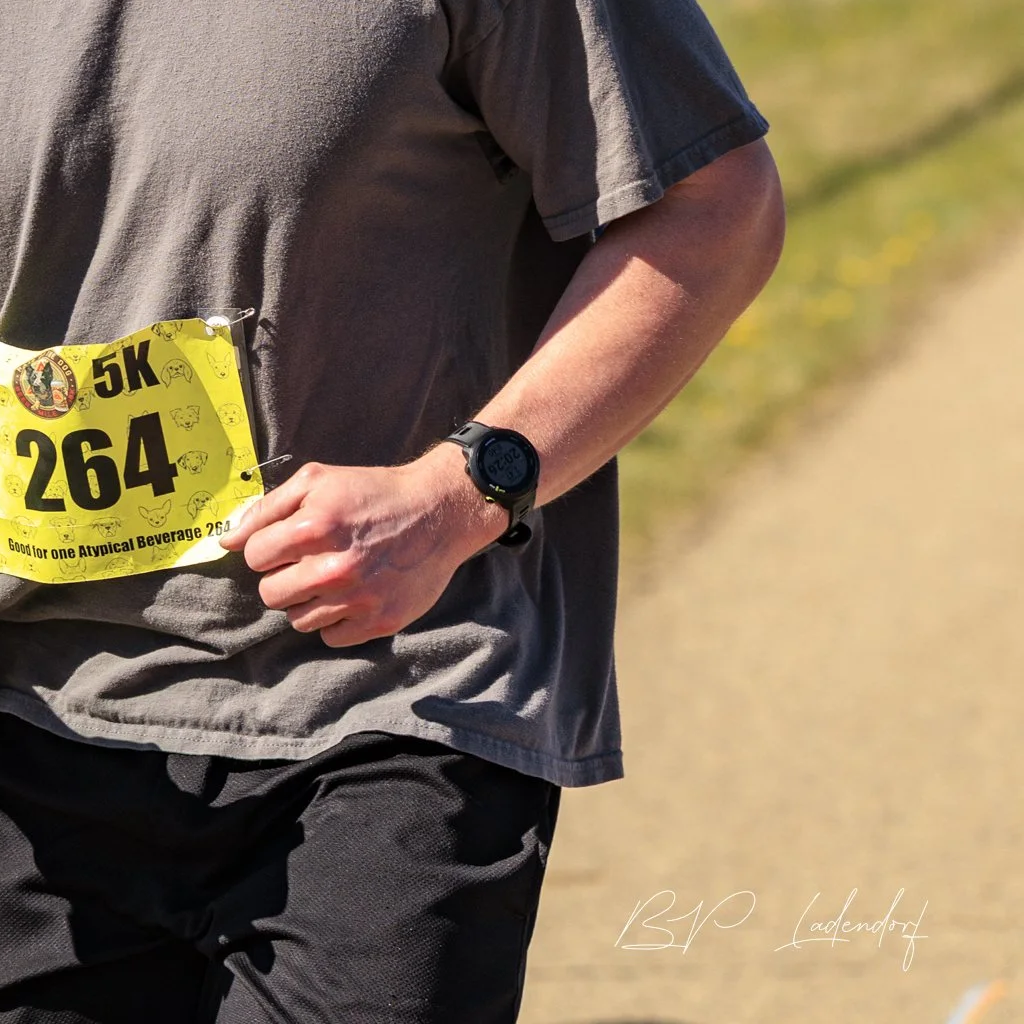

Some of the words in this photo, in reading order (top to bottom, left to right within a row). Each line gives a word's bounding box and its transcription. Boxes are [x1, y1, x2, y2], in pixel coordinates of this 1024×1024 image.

[92, 339, 161, 399] 5K
[15, 412, 179, 513] 264
[8, 537, 32, 556] Good
[32, 544, 49, 560] for
[51, 547, 76, 561] one
[78, 537, 135, 559] Atypical
[136, 524, 203, 550] Beverage
[206, 520, 232, 538] 264
